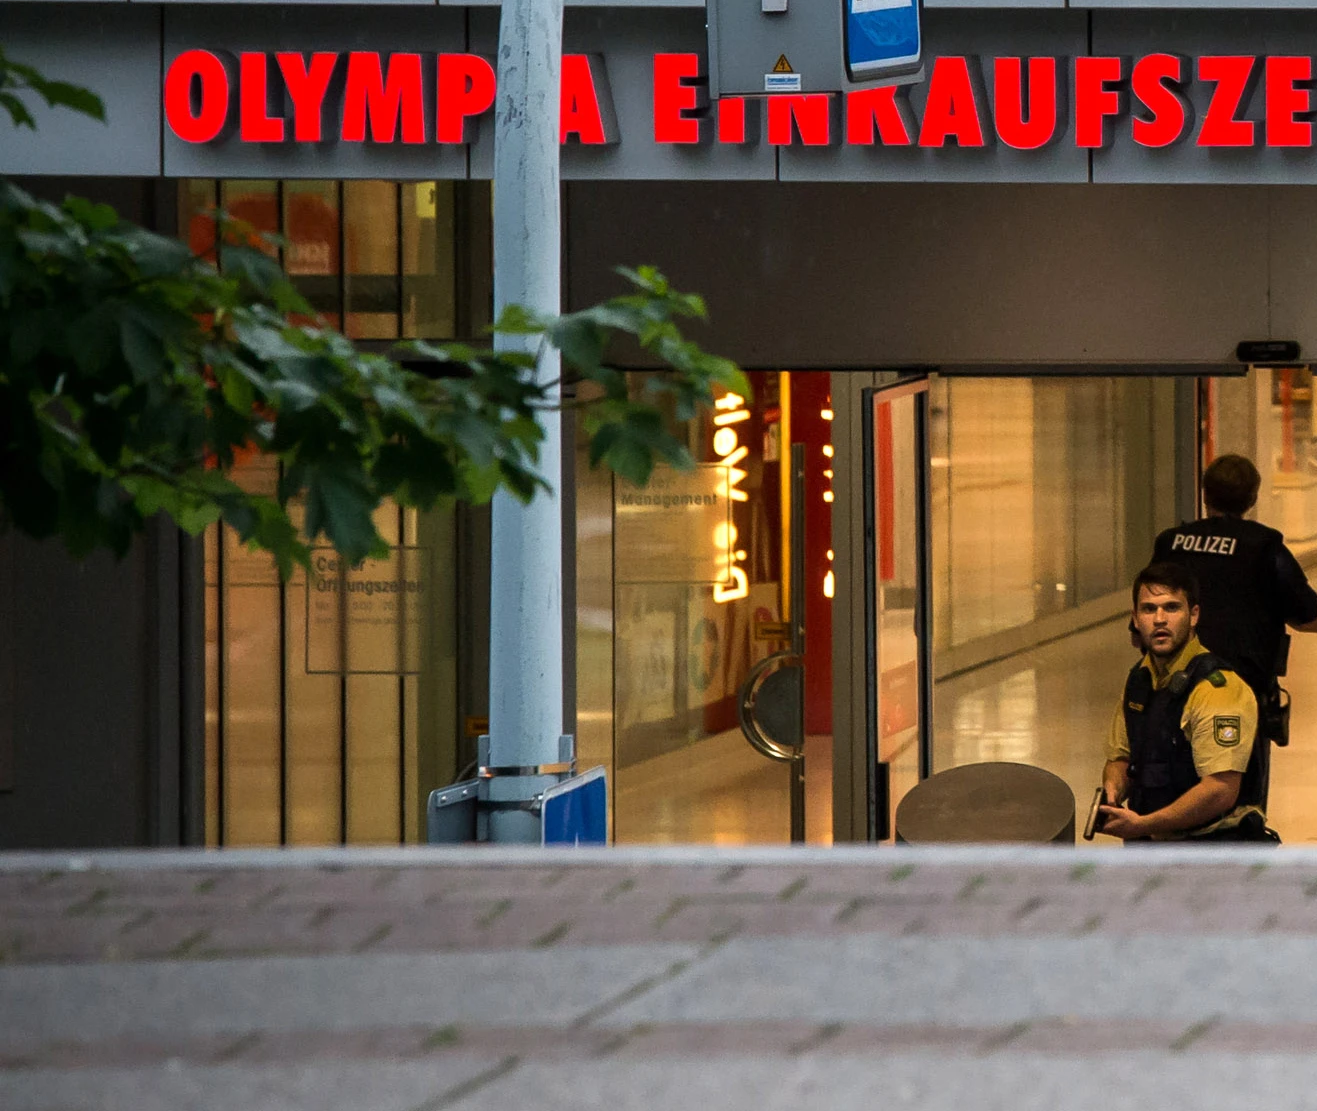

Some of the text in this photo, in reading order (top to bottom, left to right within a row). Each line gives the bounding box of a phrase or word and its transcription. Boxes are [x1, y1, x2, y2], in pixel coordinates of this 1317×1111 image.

[164, 49, 606, 145] OLYMPA
[620, 492, 718, 509] Management
[712, 391, 751, 604] Die Welt
[1171, 533, 1238, 556] POLIZEI
